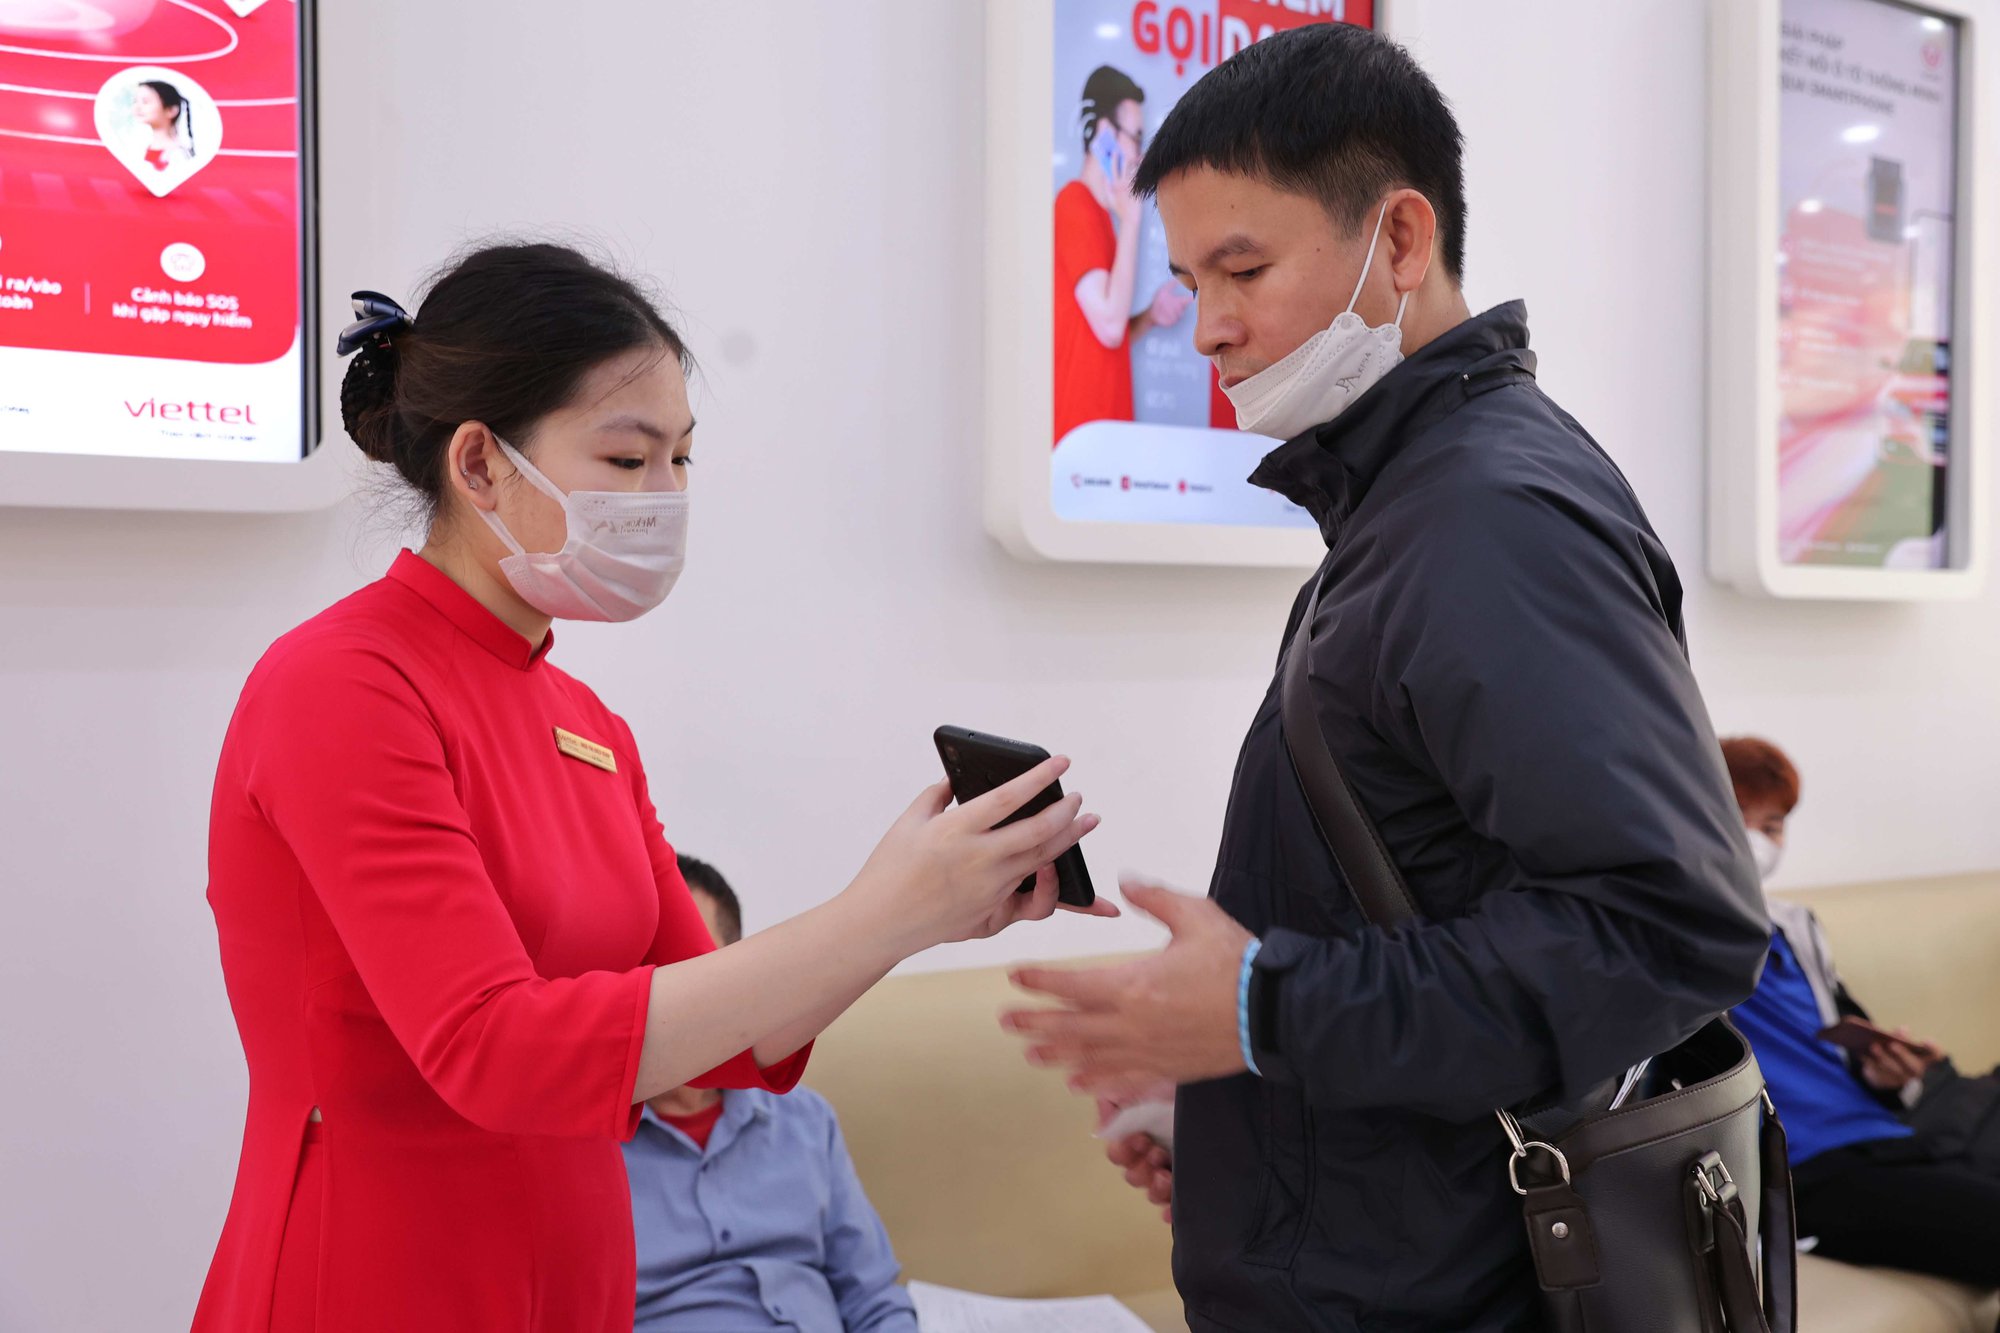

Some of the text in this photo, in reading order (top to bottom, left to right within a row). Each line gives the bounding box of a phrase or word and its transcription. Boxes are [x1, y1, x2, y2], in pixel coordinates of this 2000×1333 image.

[1132, 0, 1210, 77] GỌI
[205, 293, 240, 312] SOS
[124, 397, 257, 425] viettel
